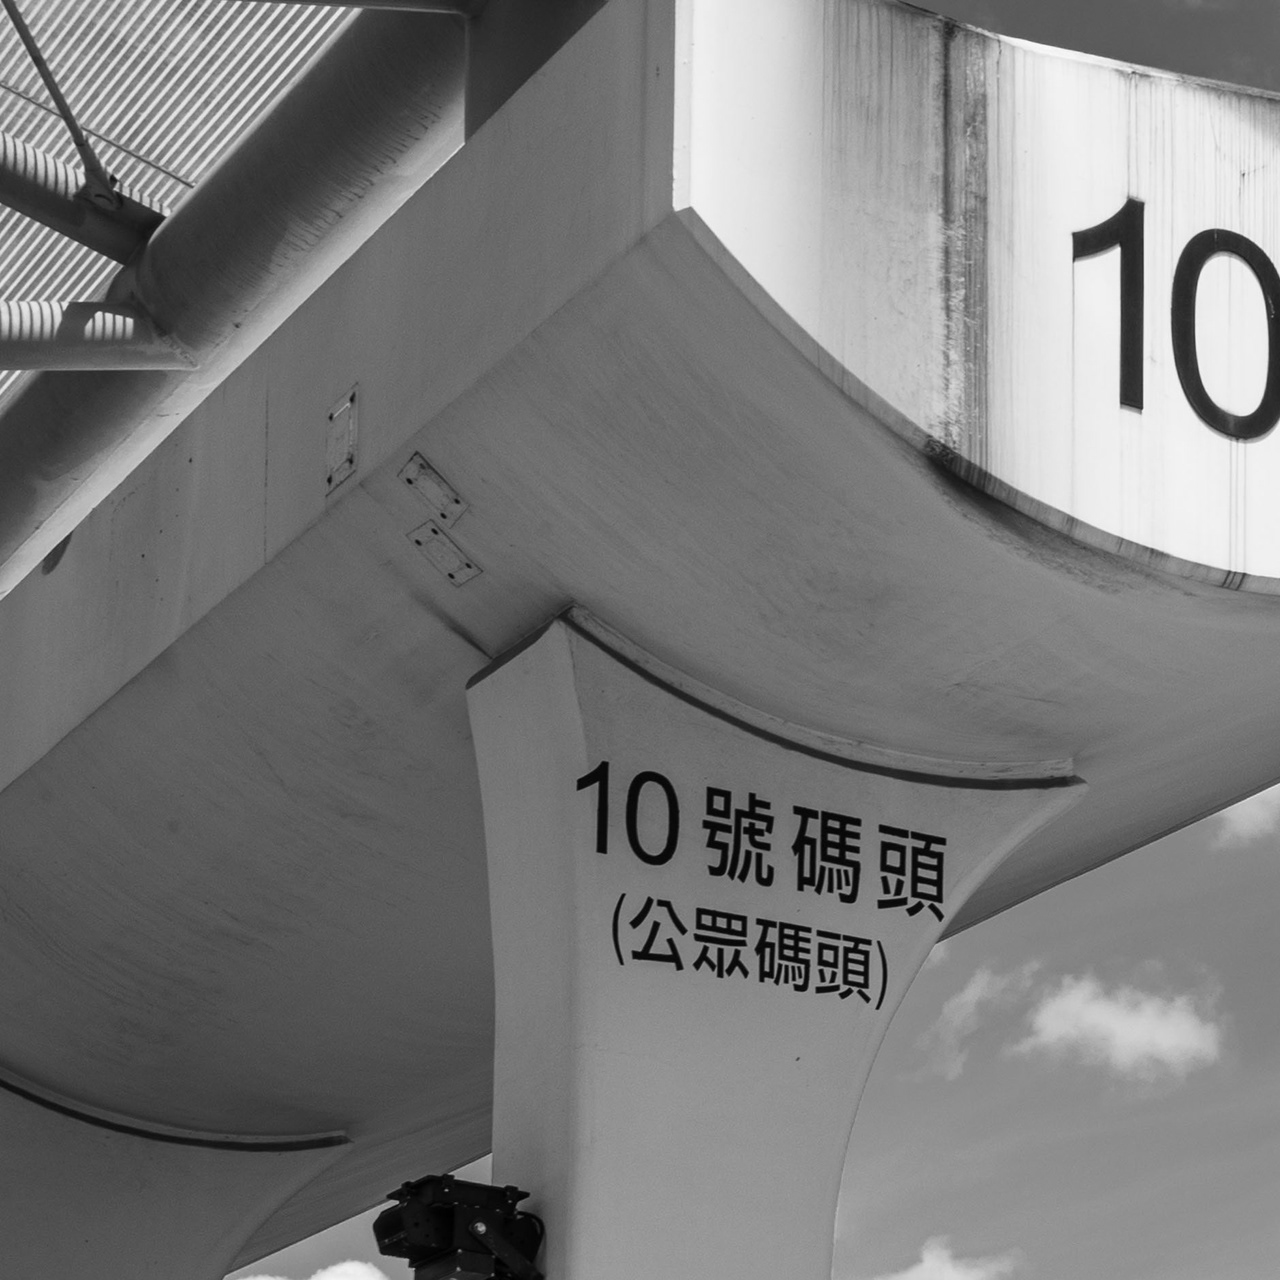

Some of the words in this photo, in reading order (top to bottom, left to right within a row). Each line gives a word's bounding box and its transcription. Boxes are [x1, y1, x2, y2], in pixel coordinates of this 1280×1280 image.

[576, 760, 947, 922] 10號碼頭
[611, 893, 889, 1011] (公眾碼頭)
